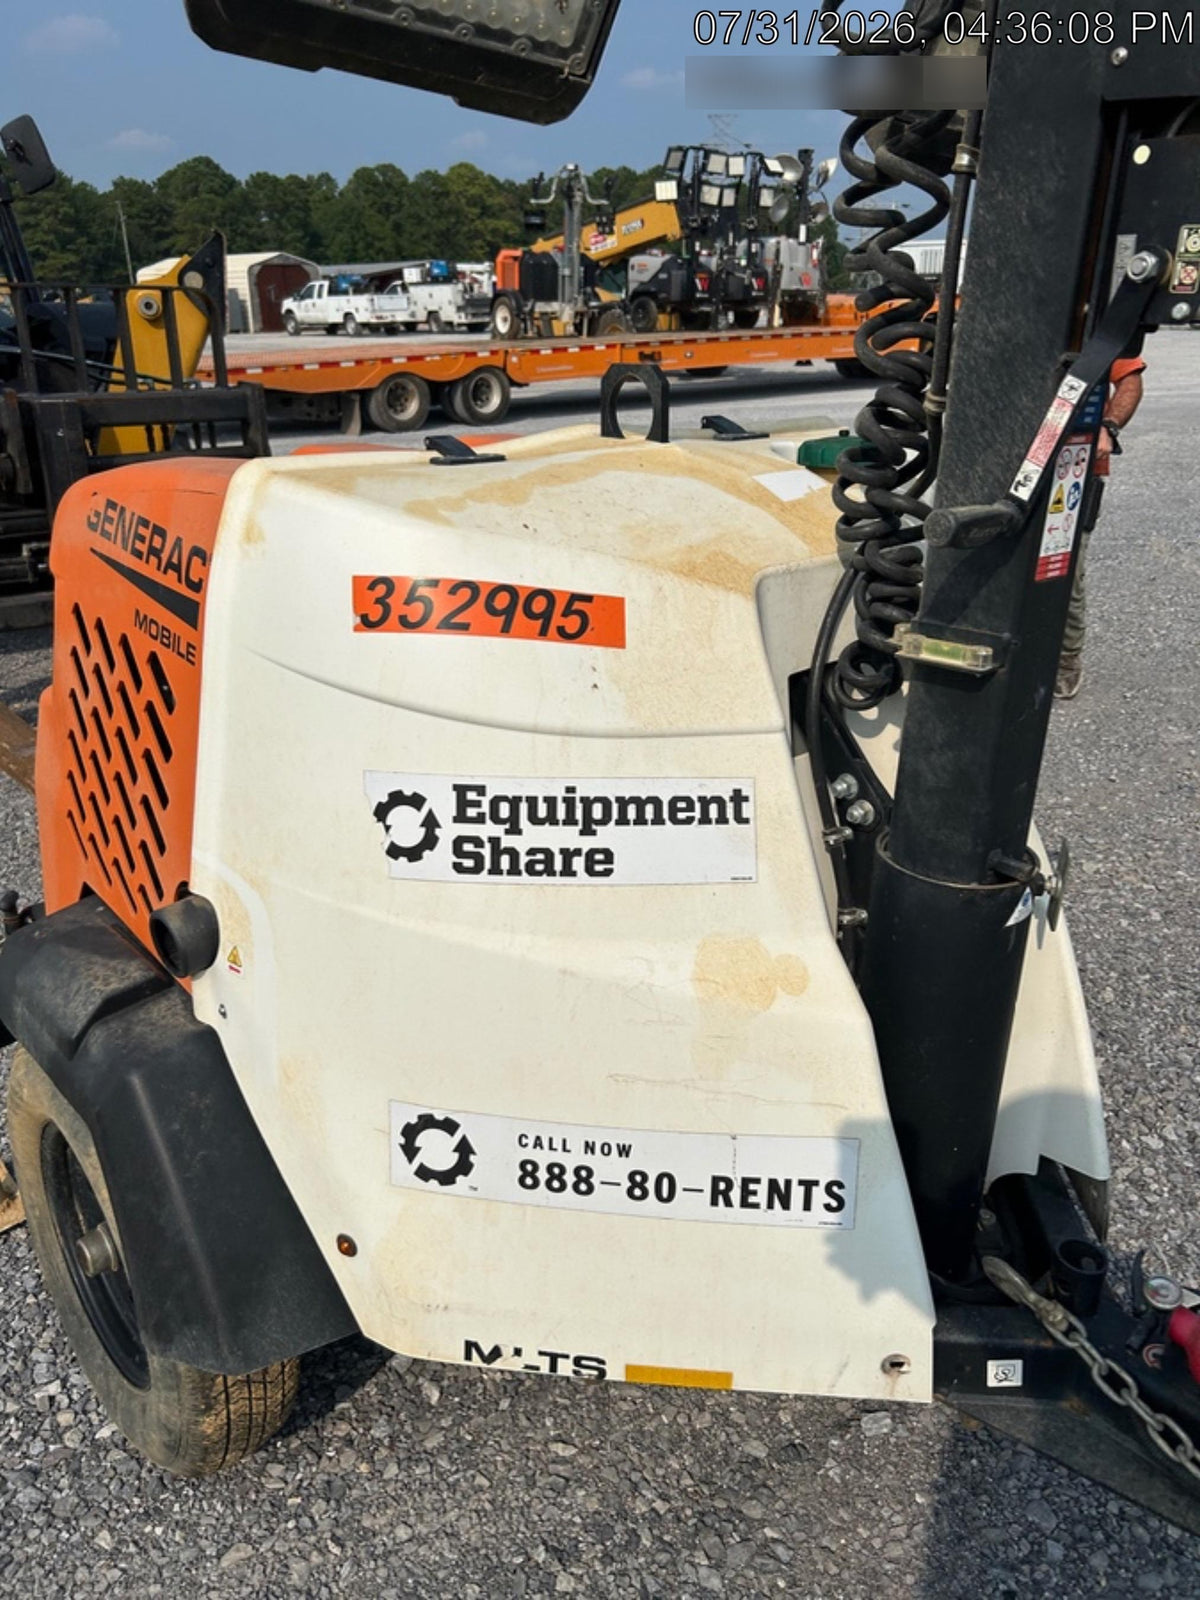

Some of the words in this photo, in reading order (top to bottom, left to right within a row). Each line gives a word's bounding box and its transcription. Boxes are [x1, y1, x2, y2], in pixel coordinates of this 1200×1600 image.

[360, 576, 594, 641] 352995
[134, 607, 197, 667] MOBILE
[452, 783, 750, 836] Equipment
[452, 834, 614, 878] Share
[517, 1133, 572, 1154] CALL
[584, 1139, 633, 1159] NOW
